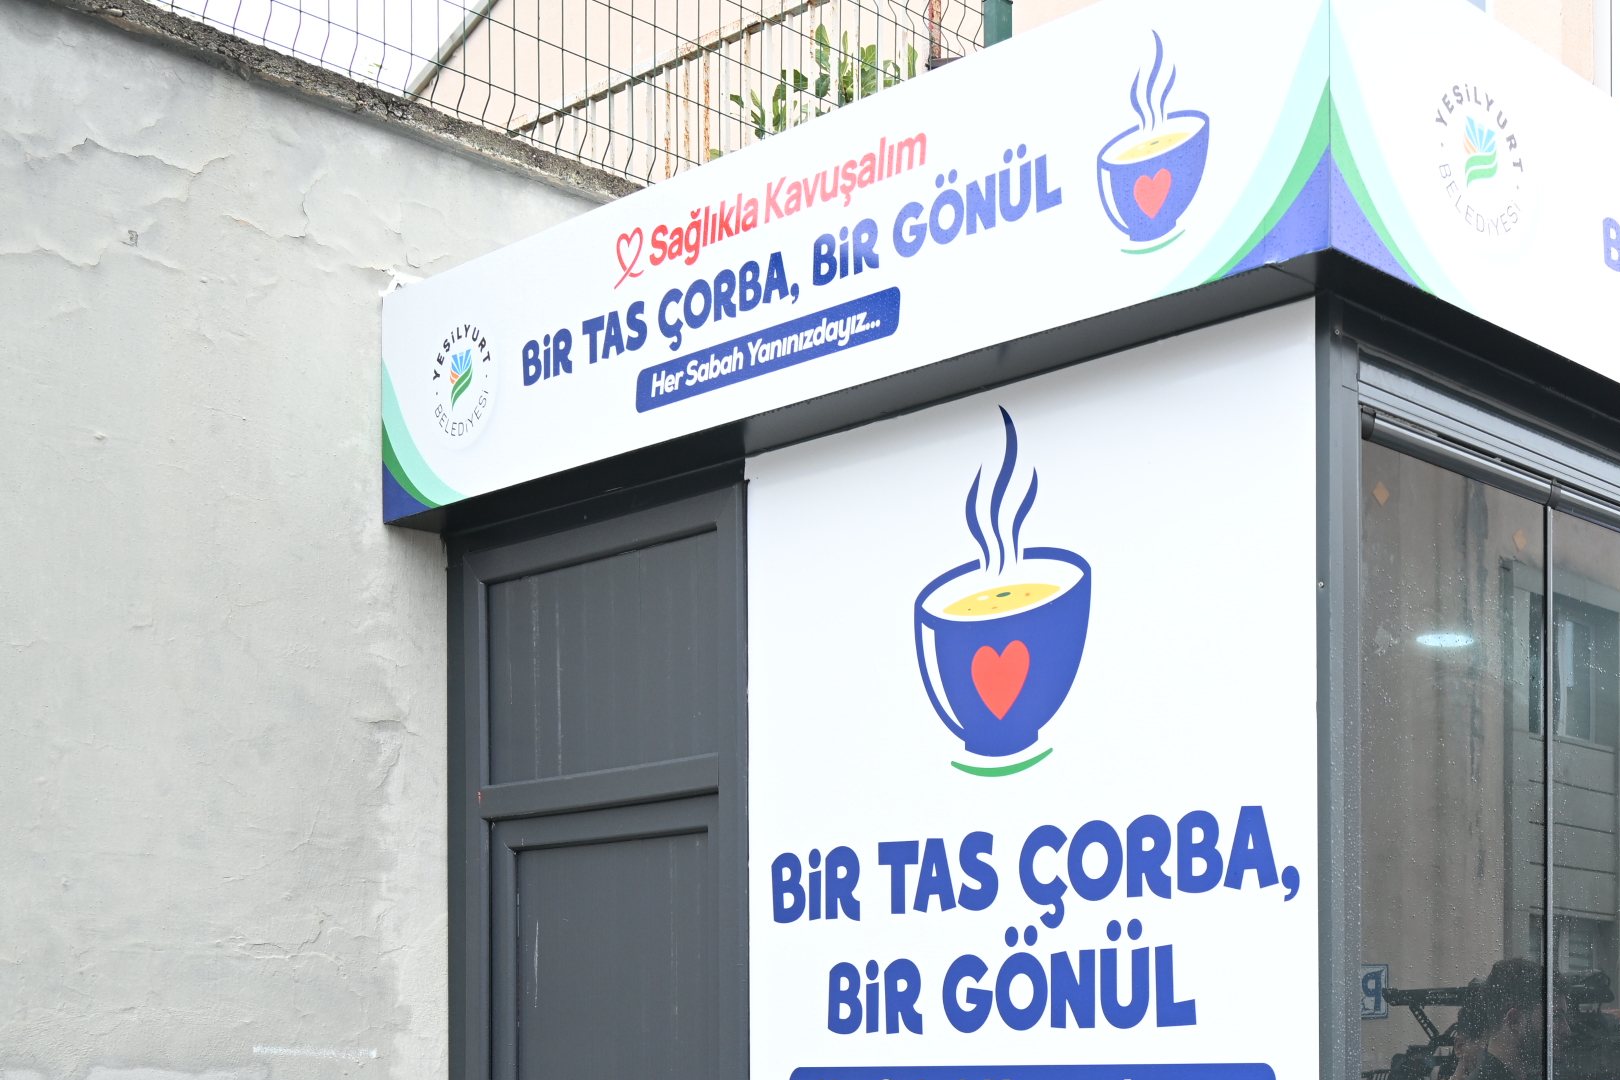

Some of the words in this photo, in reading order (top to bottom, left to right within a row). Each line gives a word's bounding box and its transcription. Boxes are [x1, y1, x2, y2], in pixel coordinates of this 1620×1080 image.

[582, 301, 647, 364] TAS
[658, 251, 799, 351] ÇORBA,
[893, 144, 1062, 258] GÖNÜL
[649, 193, 758, 266] Sağlıkla
[764, 133, 926, 224] Kavuşalım
[652, 371, 684, 397] Her
[686, 347, 743, 386] Sabah
[748, 312, 880, 365] Yanınızdayız...
[878, 831, 999, 914] TAS
[1019, 806, 1300, 929] ÇORBA,
[942, 919, 1197, 1033] GÖNÜL
